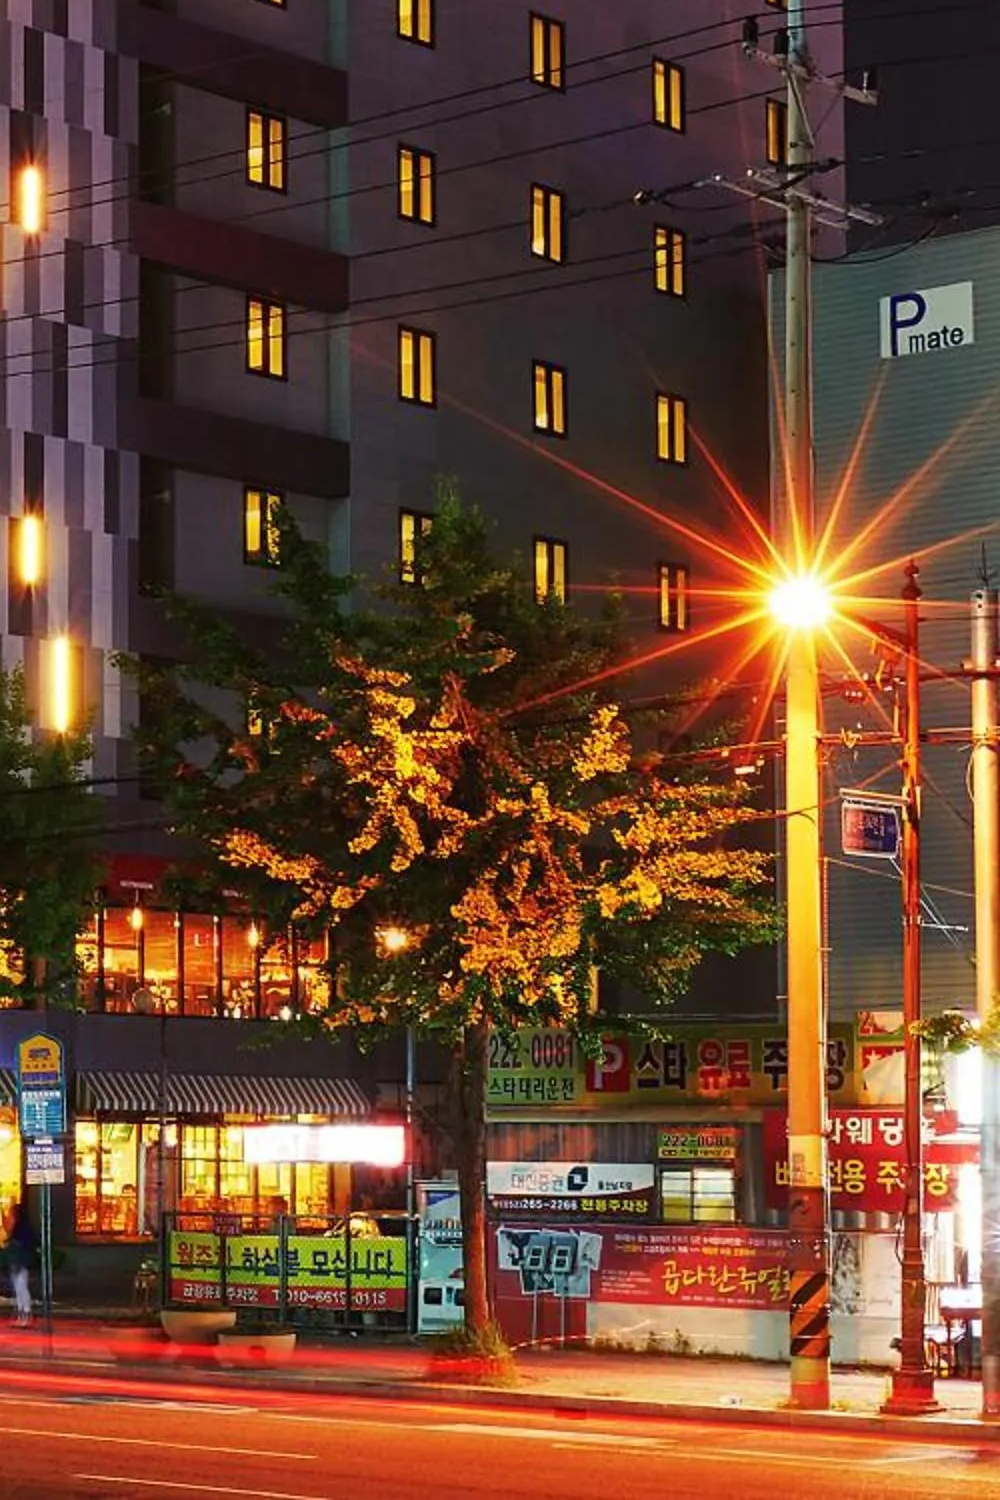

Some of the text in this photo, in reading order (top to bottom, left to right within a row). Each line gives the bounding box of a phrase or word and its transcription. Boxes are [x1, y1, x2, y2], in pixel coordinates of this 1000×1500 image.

[488, 1033, 574, 1069] 222-0081
[697, 1038, 752, 1092] 유료
[762, 1039, 848, 1092] 주장
[877, 1160, 951, 1196] 주장
